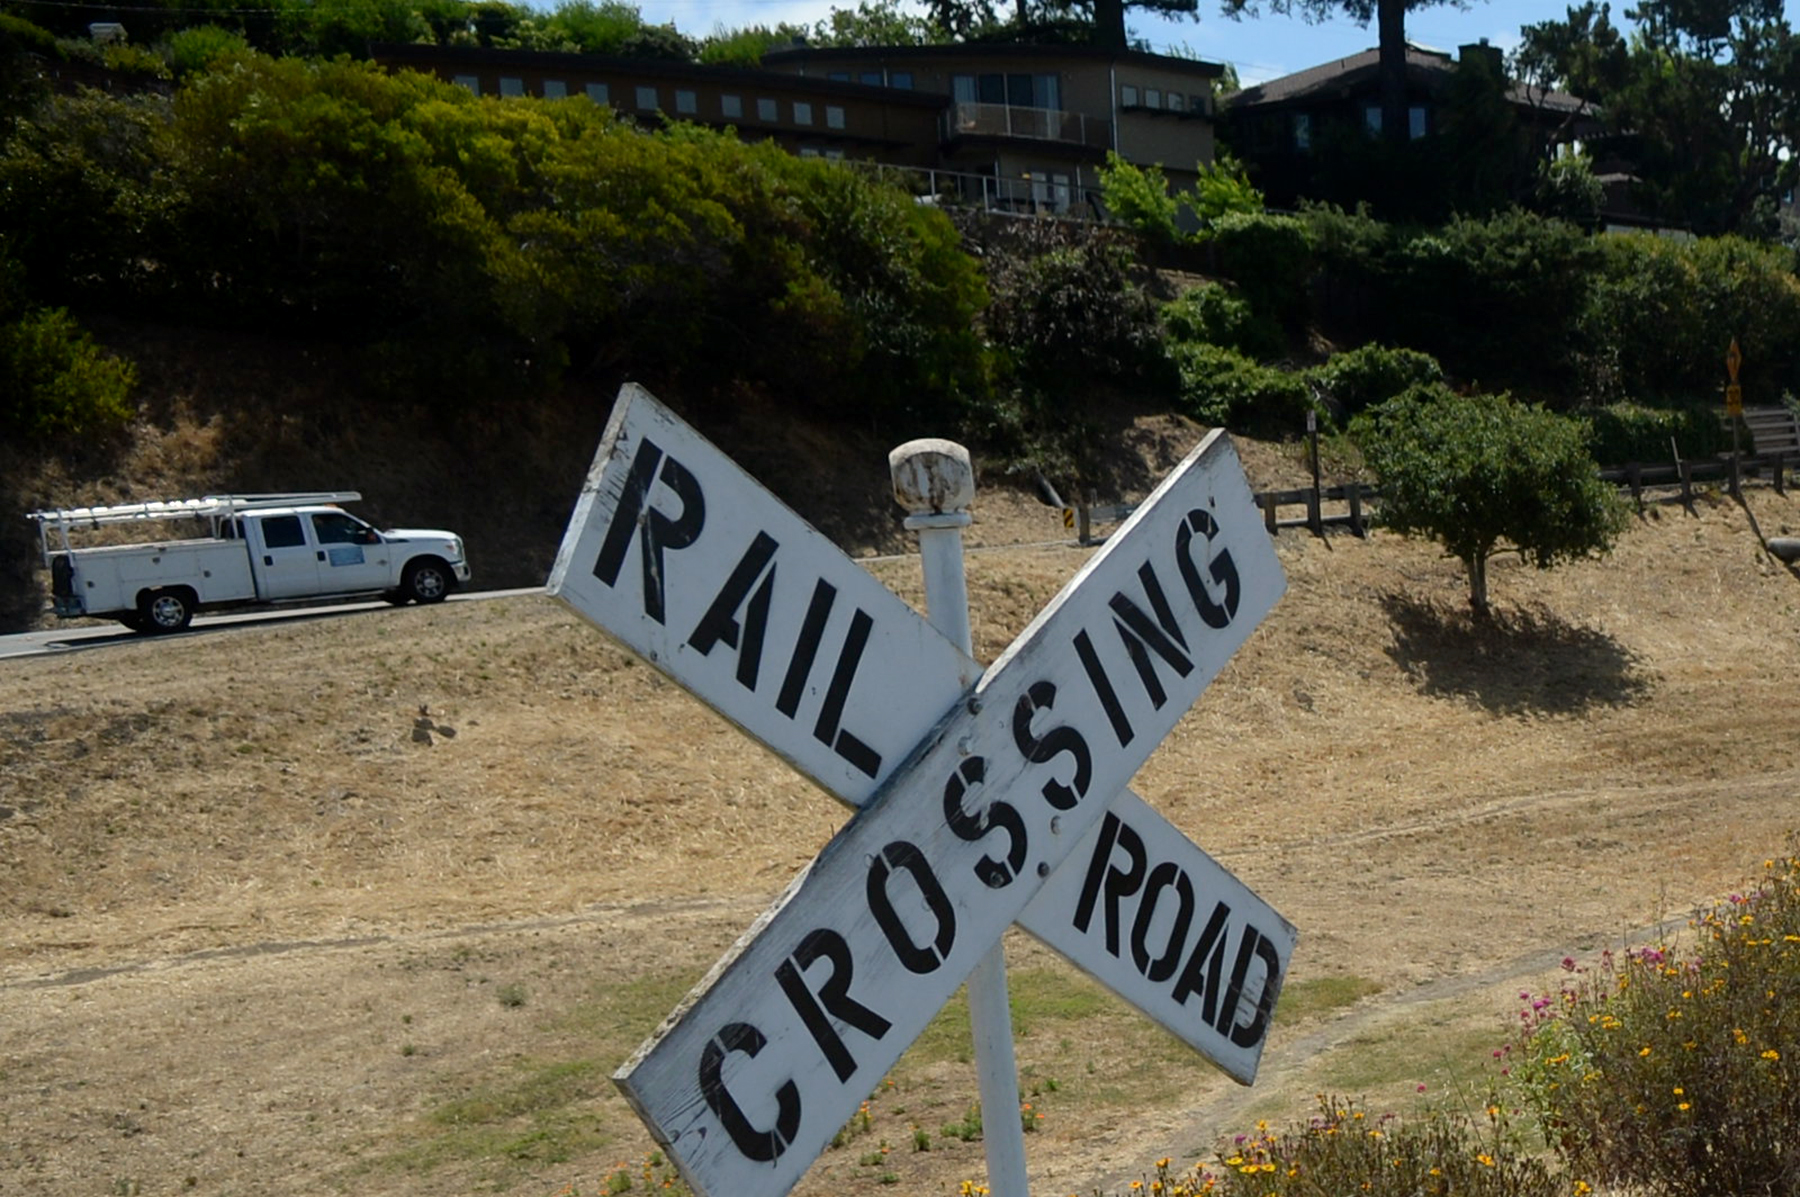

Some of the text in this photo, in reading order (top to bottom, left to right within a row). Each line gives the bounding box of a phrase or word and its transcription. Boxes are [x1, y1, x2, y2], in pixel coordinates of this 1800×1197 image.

[592, 437, 1283, 1050] RAIL ROAD
[698, 508, 1242, 1163] CROSSING
